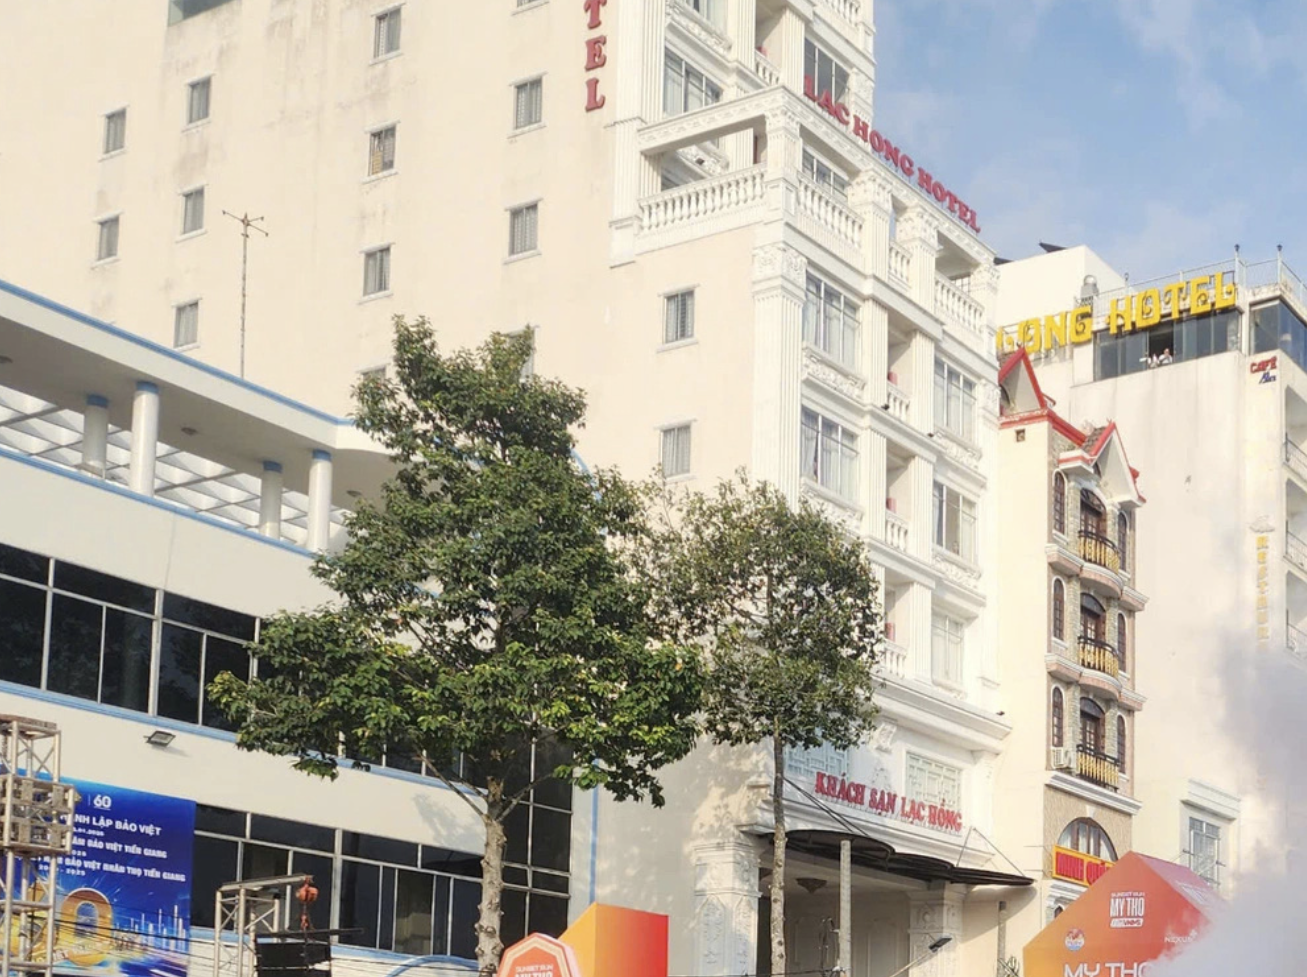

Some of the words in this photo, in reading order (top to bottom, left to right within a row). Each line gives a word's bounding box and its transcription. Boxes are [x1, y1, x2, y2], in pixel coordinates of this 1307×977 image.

[803, 74, 850, 126] LAC
[853, 114, 914, 177] HONG
[917, 166, 981, 233] HOTEL
[1105, 271, 1237, 335] HOTEL
[93, 794, 112, 809] 60
[814, 771, 865, 806] KHÁCH
[900, 796, 926, 825] LẠC
[115, 820, 137, 833] BẢO
[138, 823, 162, 836] VIỆT
[1110, 898, 1125, 917] MY
[1126, 897, 1145, 917] THO
